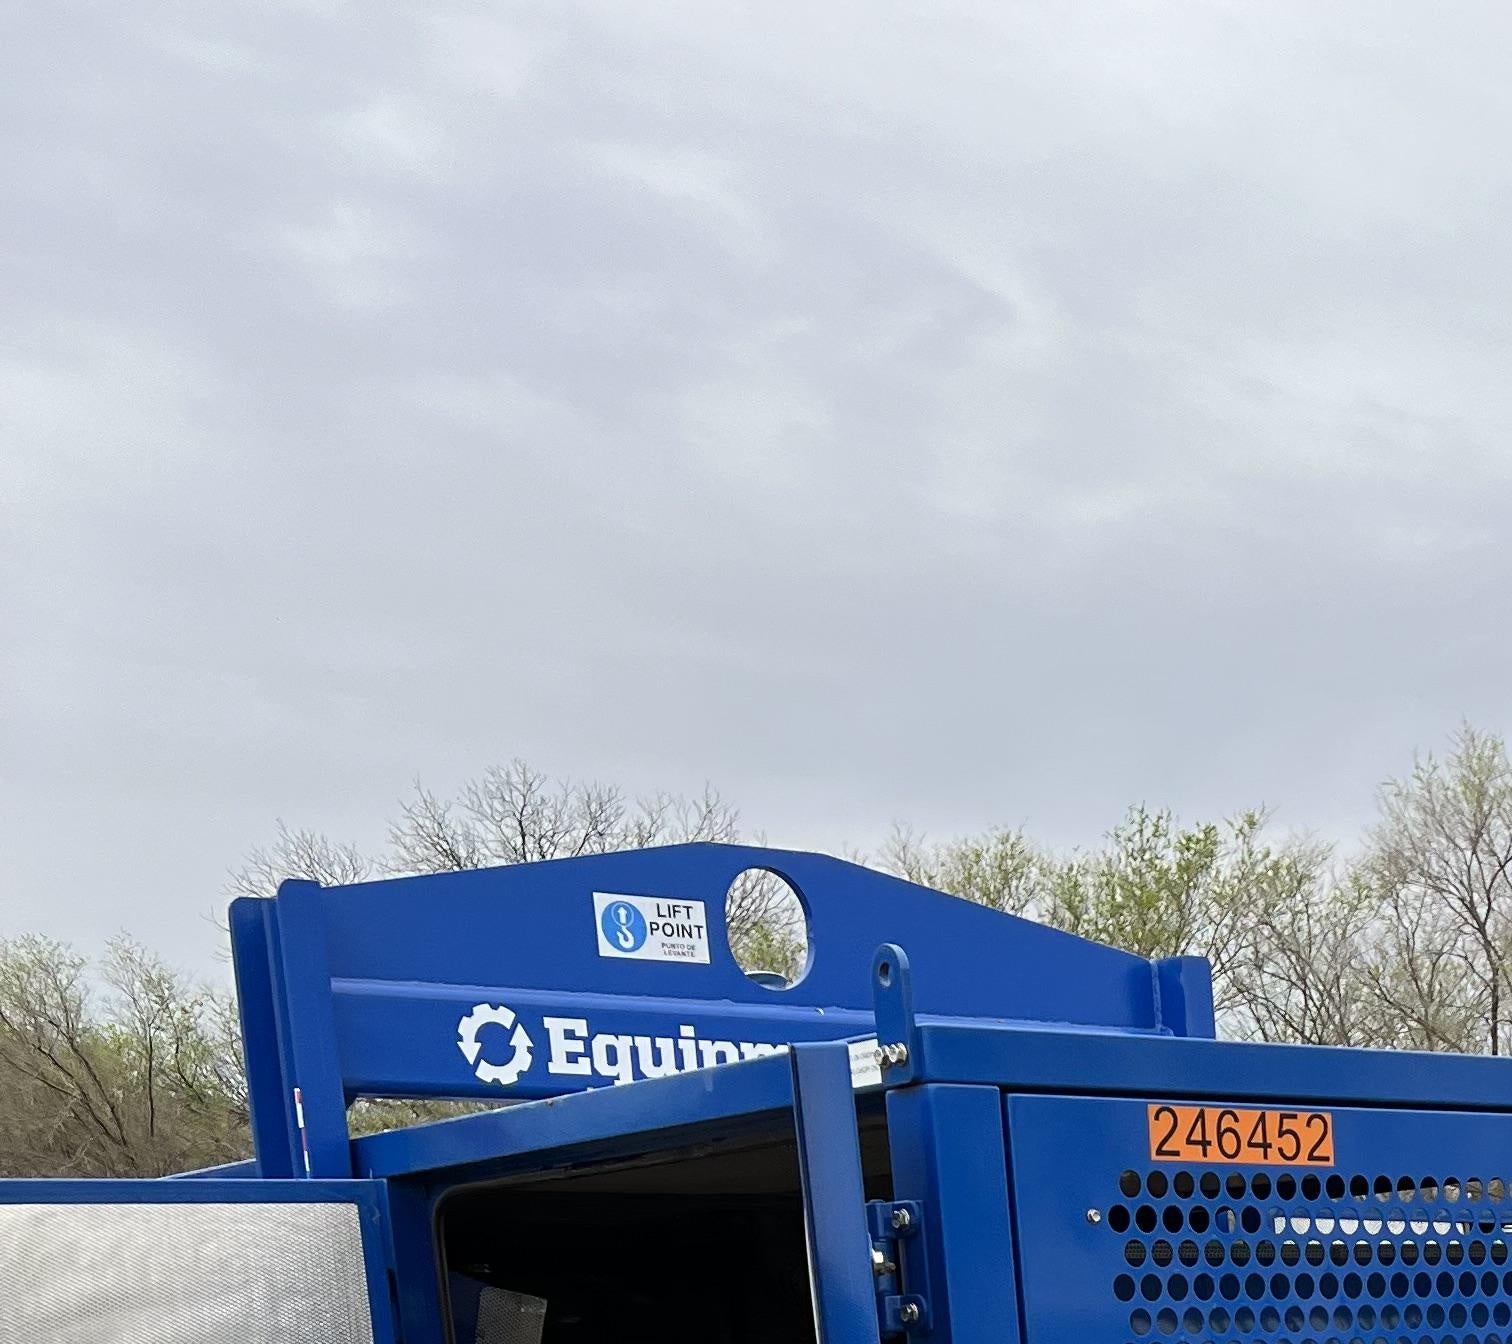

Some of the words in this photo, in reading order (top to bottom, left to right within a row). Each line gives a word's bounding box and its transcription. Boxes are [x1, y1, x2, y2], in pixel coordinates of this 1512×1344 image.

[656, 903, 694, 920] LIFT
[649, 921, 704, 940] POINT
[1153, 1106, 1330, 1162] 246452
